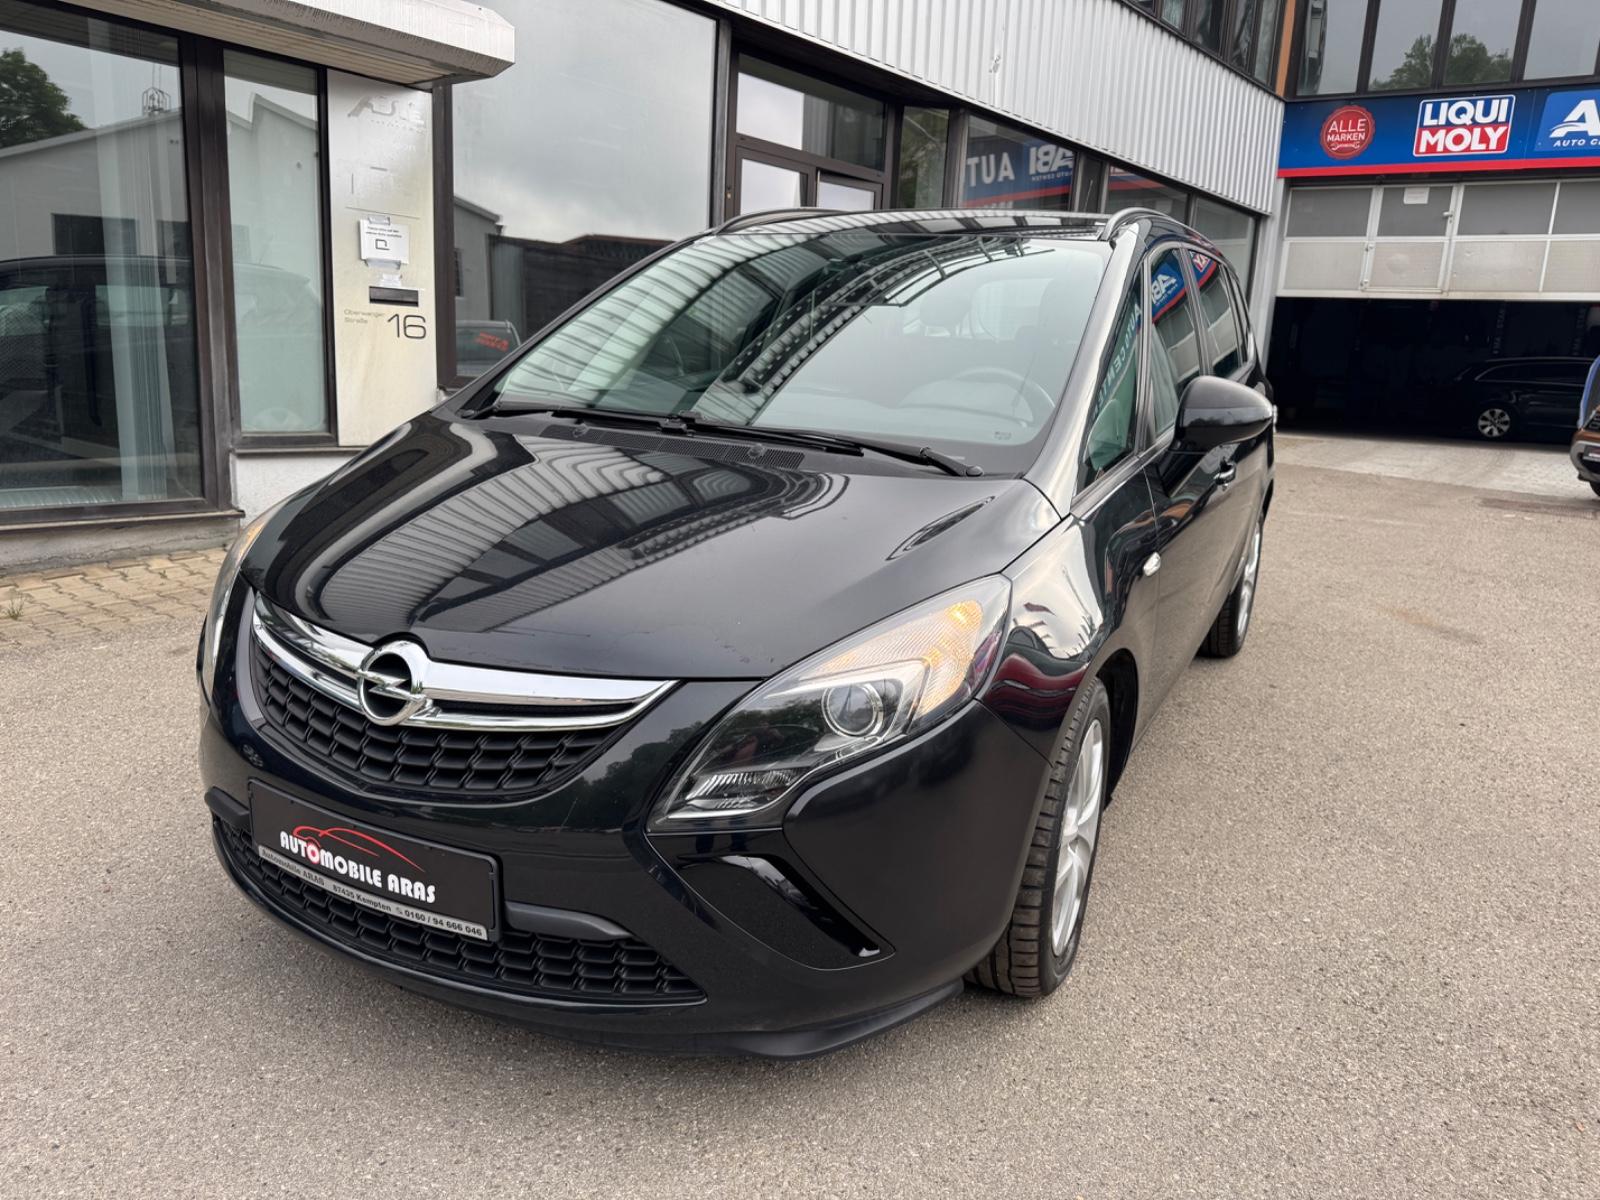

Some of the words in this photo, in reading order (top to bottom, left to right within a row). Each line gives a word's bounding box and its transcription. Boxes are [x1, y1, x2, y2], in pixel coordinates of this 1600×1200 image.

[1328, 118, 1367, 133] ALLE
[1423, 99, 1509, 126] LIQUI
[1327, 132, 1366, 142] MARKEN
[1419, 126, 1508, 153] MOLY
[1553, 139, 1586, 147] AUTO
[1590, 138, 1600, 146] C
[387, 313, 427, 339] 16
[280, 831, 383, 887] AUTOMOBILE
[387, 873, 436, 903] ARAS
[355, 892, 392, 912] Kempten
[404, 909, 426, 922] 0160
[432, 917, 444, 926] 94
[446, 920, 463, 931] 666
[465, 925, 483, 936] 046
